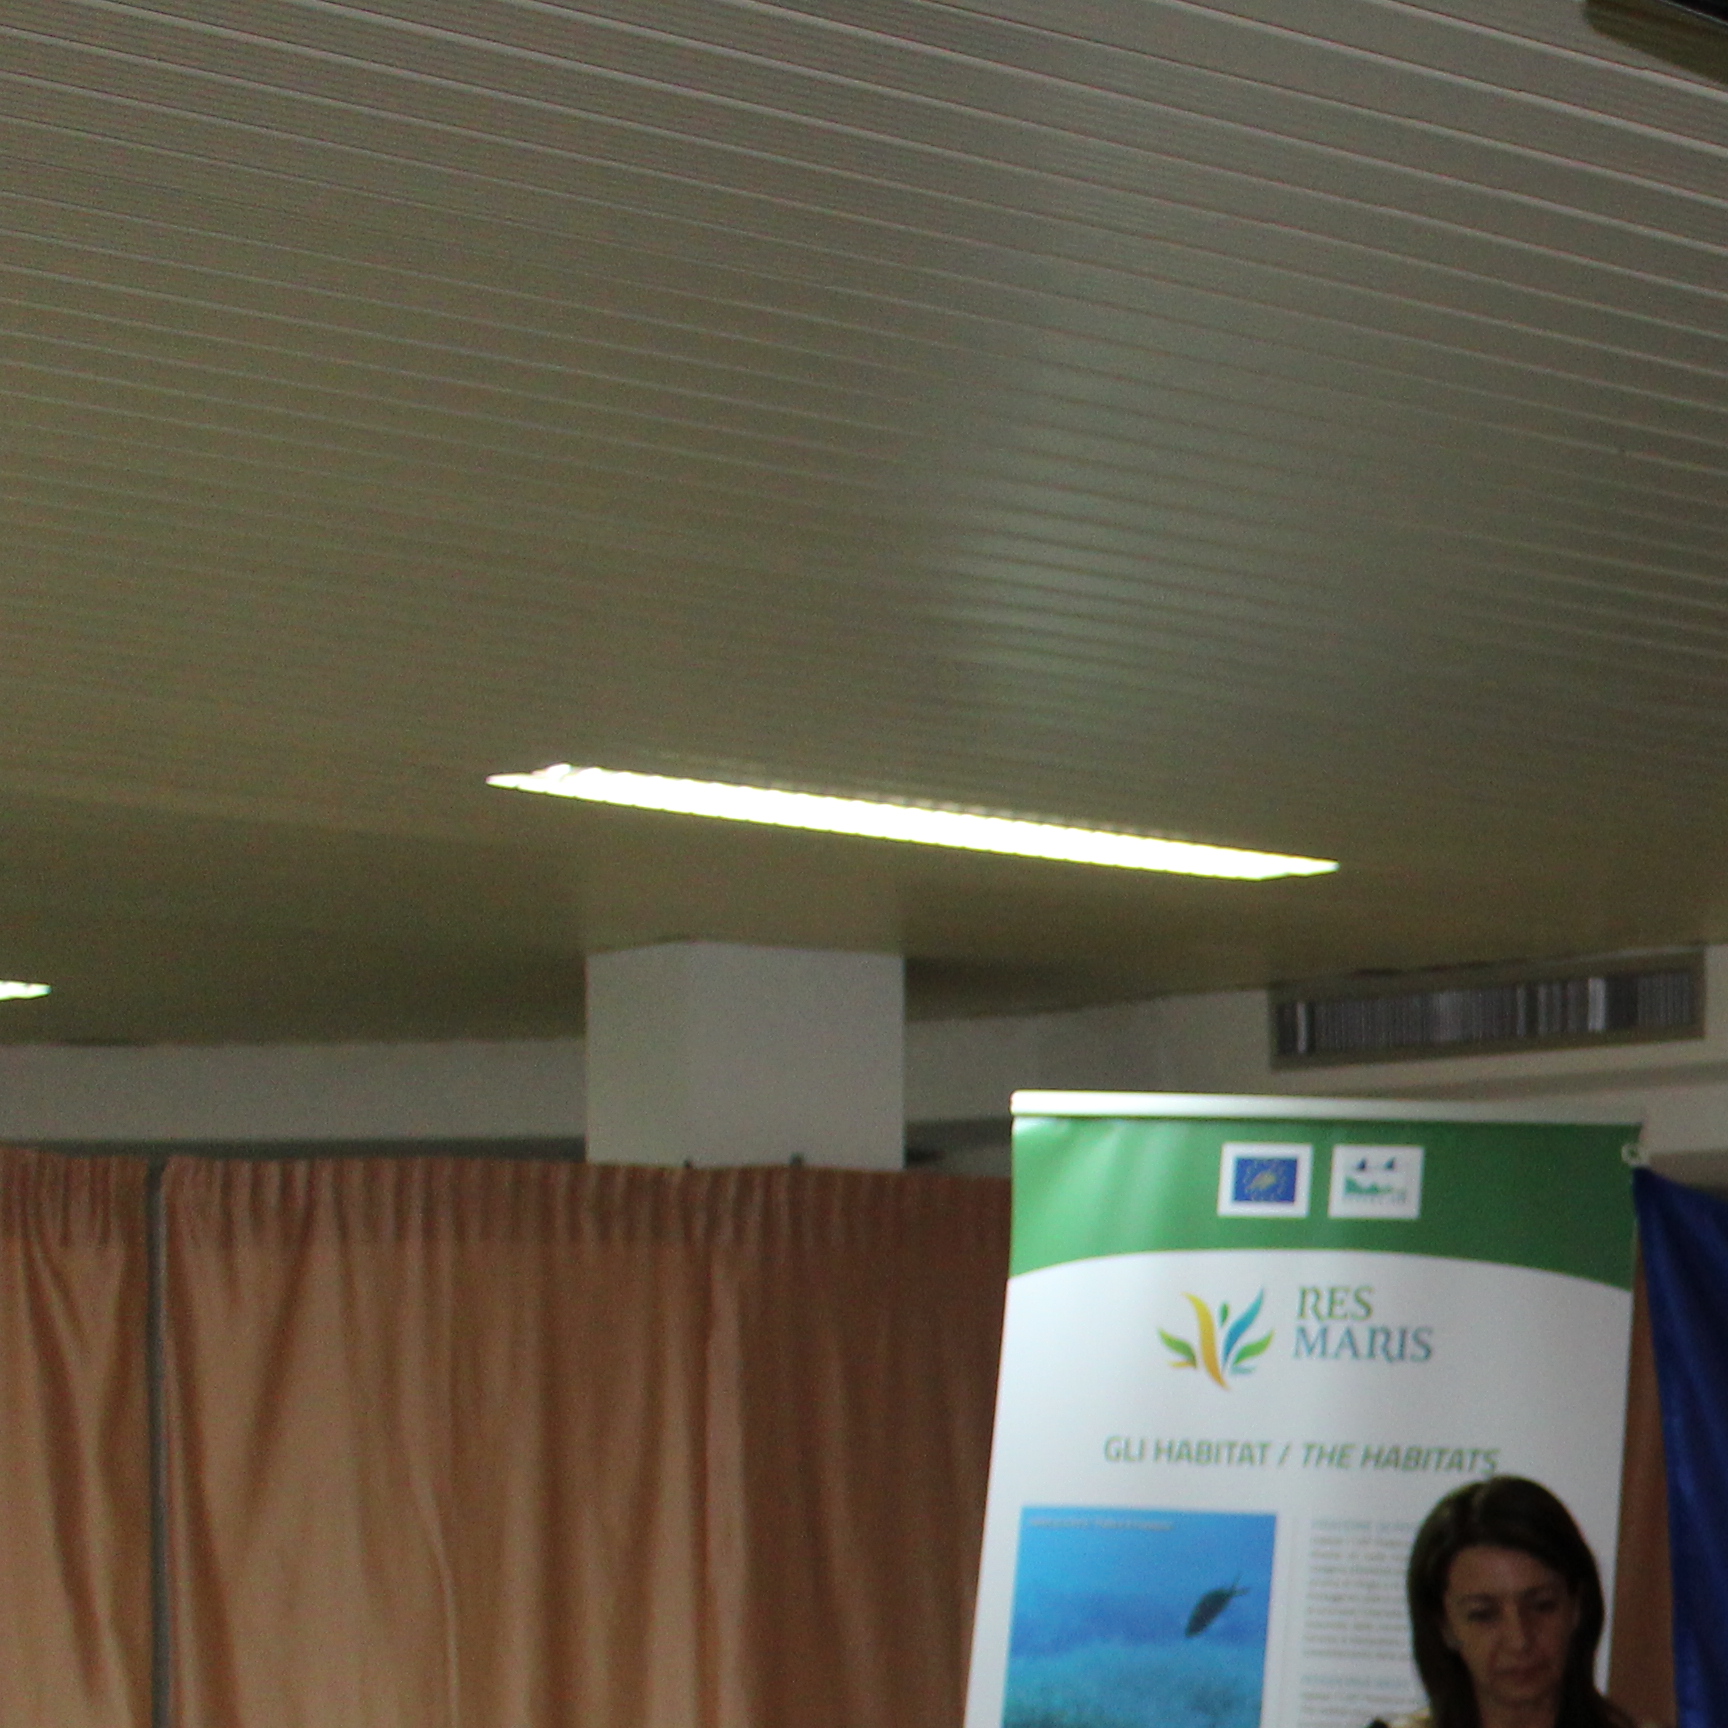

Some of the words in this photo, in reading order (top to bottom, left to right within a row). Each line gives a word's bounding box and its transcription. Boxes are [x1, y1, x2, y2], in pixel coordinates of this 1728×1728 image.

[1297, 1284, 1374, 1322] RES
[1293, 1325, 1434, 1363] MARIS
[1103, 1435, 1145, 1463] GLI
[1152, 1438, 1271, 1467] HABITAT
[1302, 1441, 1357, 1469] THE
[1360, 1443, 1502, 1475] HABITATS
